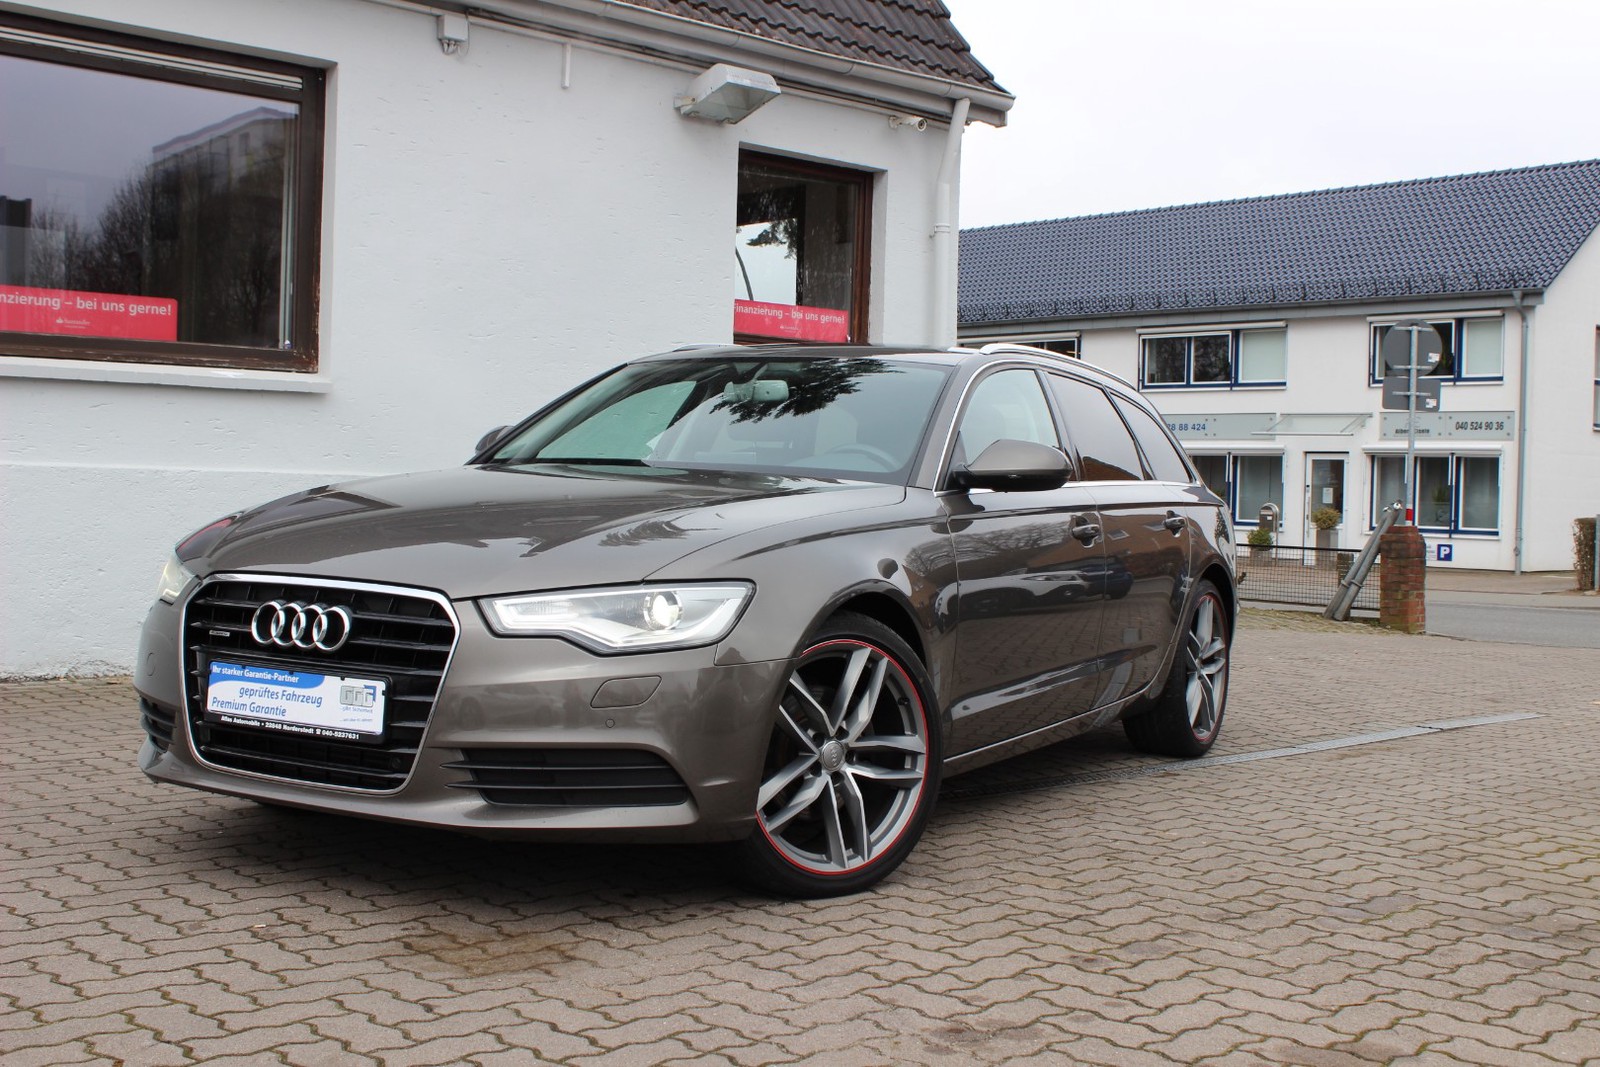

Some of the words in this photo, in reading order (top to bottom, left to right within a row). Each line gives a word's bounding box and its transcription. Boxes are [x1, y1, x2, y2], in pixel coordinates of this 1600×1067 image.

[76, 296, 98, 310] bei
[102, 301, 125, 312] uns
[129, 304, 172, 316] gerne!
[791, 309, 803, 319] bei
[805, 313, 819, 321] uns
[820, 314, 844, 324] gerne!
[1179, 423, 1188, 431] 88
[1191, 423, 1205, 431] 424
[1455, 421, 1468, 430] 040
[1470, 421, 1483, 431] 524
[1484, 421, 1494, 431] 90
[1495, 421, 1505, 431] 36
[212, 664, 222, 673] Ihr
[222, 667, 243, 677] starker
[244, 669, 299, 684] Garantie-Partner
[239, 686, 280, 700] geprüftes
[280, 689, 323, 708] Fahrzeug
[211, 697, 248, 711] Premium
[249, 702, 287, 717] Garantie
[233, 718, 261, 727] Automobile
[282, 724, 314, 735] Norderstedt
